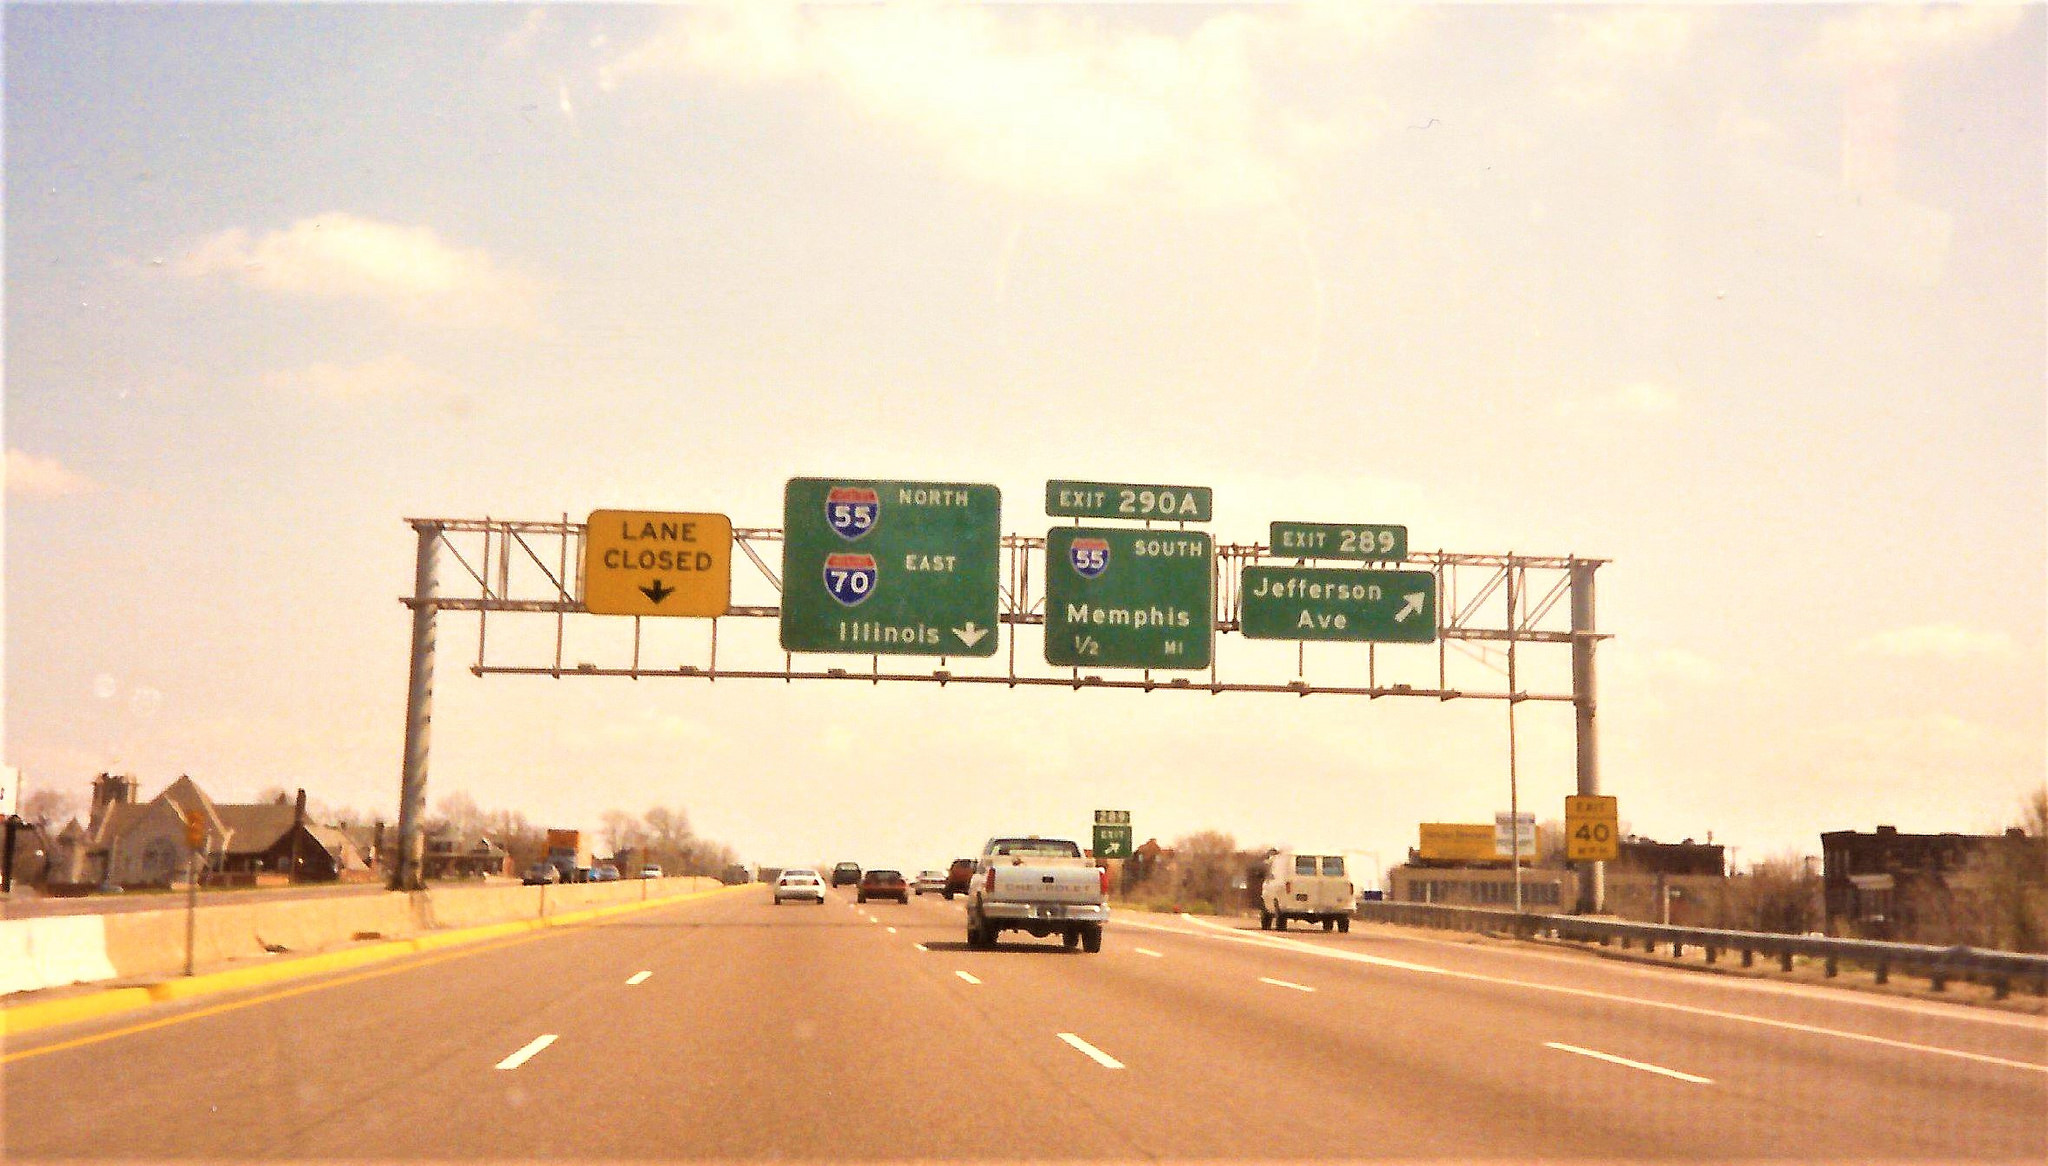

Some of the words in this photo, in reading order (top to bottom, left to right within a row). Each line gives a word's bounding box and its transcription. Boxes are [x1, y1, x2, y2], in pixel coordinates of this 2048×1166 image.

[900, 488, 968, 507] NORTH
[1060, 489, 1105, 508] EXIT
[1119, 490, 1198, 515] 290A
[834, 505, 872, 528] 55
[622, 521, 697, 541] LANE
[1283, 530, 1326, 548] EXIT
[1340, 529, 1395, 553] 289
[1135, 539, 1202, 557] SOUTH
[604, 549, 713, 571] CLOSED
[906, 554, 956, 572] EAST
[1076, 550, 1104, 569] 55
[831, 571, 869, 593] 70
[1253, 577, 1382, 600] Jefferson
[1067, 603, 1190, 629] Memphis
[1298, 609, 1347, 630] Ave
[840, 620, 940, 645] Illinois
[1164, 640, 1183, 655] MI
[1575, 823, 1610, 842] 40
